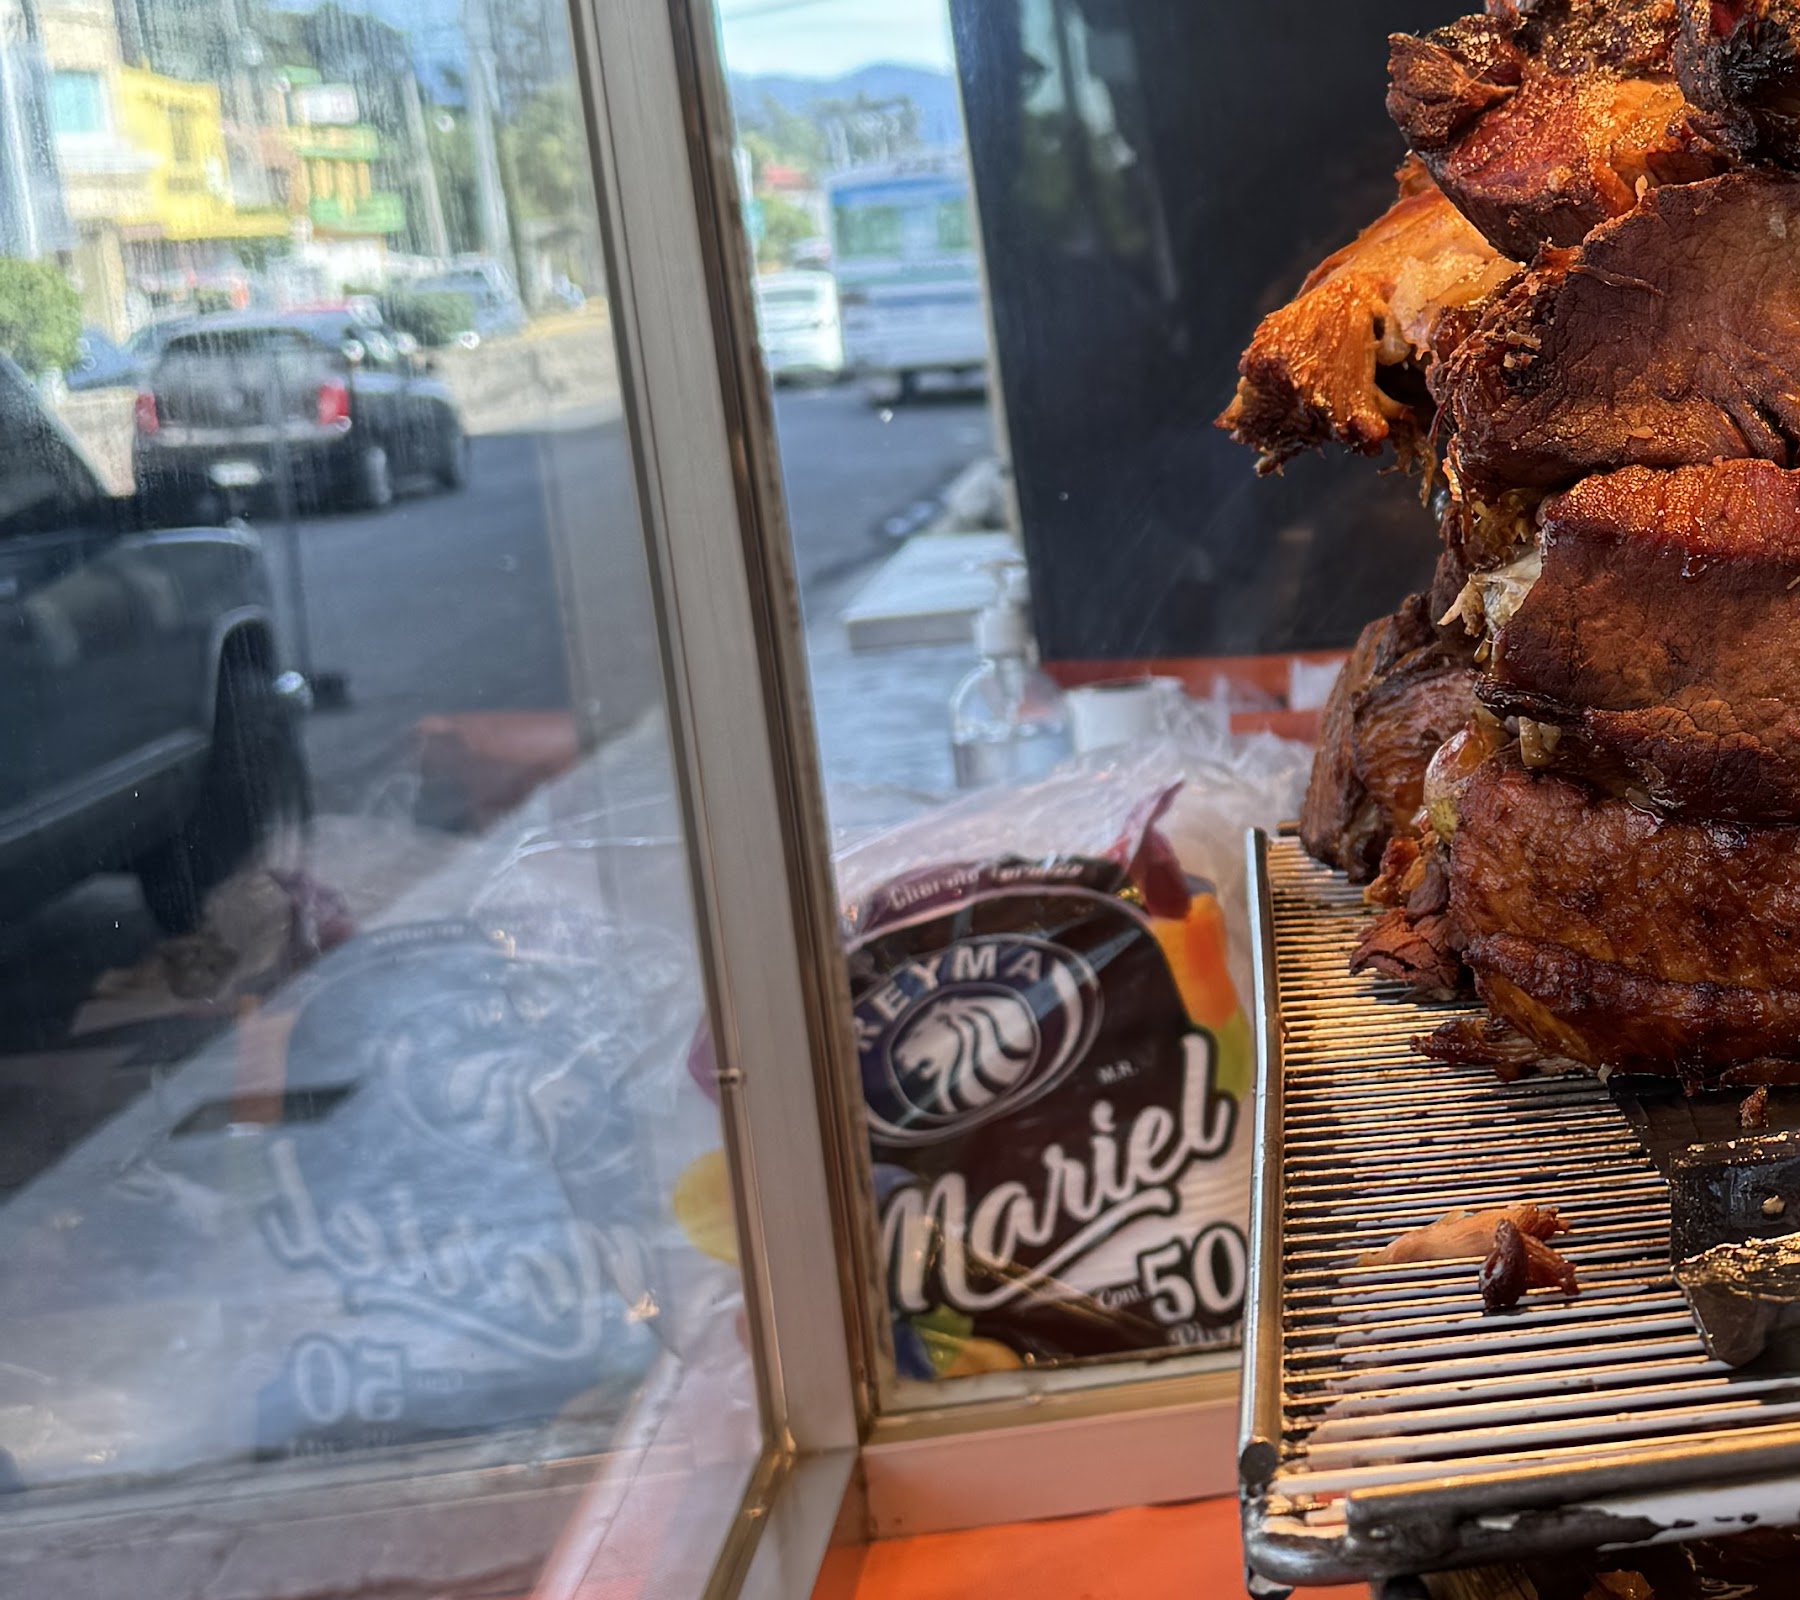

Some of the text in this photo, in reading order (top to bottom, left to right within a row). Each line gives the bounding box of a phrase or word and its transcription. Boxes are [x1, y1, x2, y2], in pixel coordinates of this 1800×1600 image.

[853, 943, 1045, 1052] REYMA
[882, 1032, 1232, 1312] Mariel
[1139, 1225, 1247, 1324] 50
